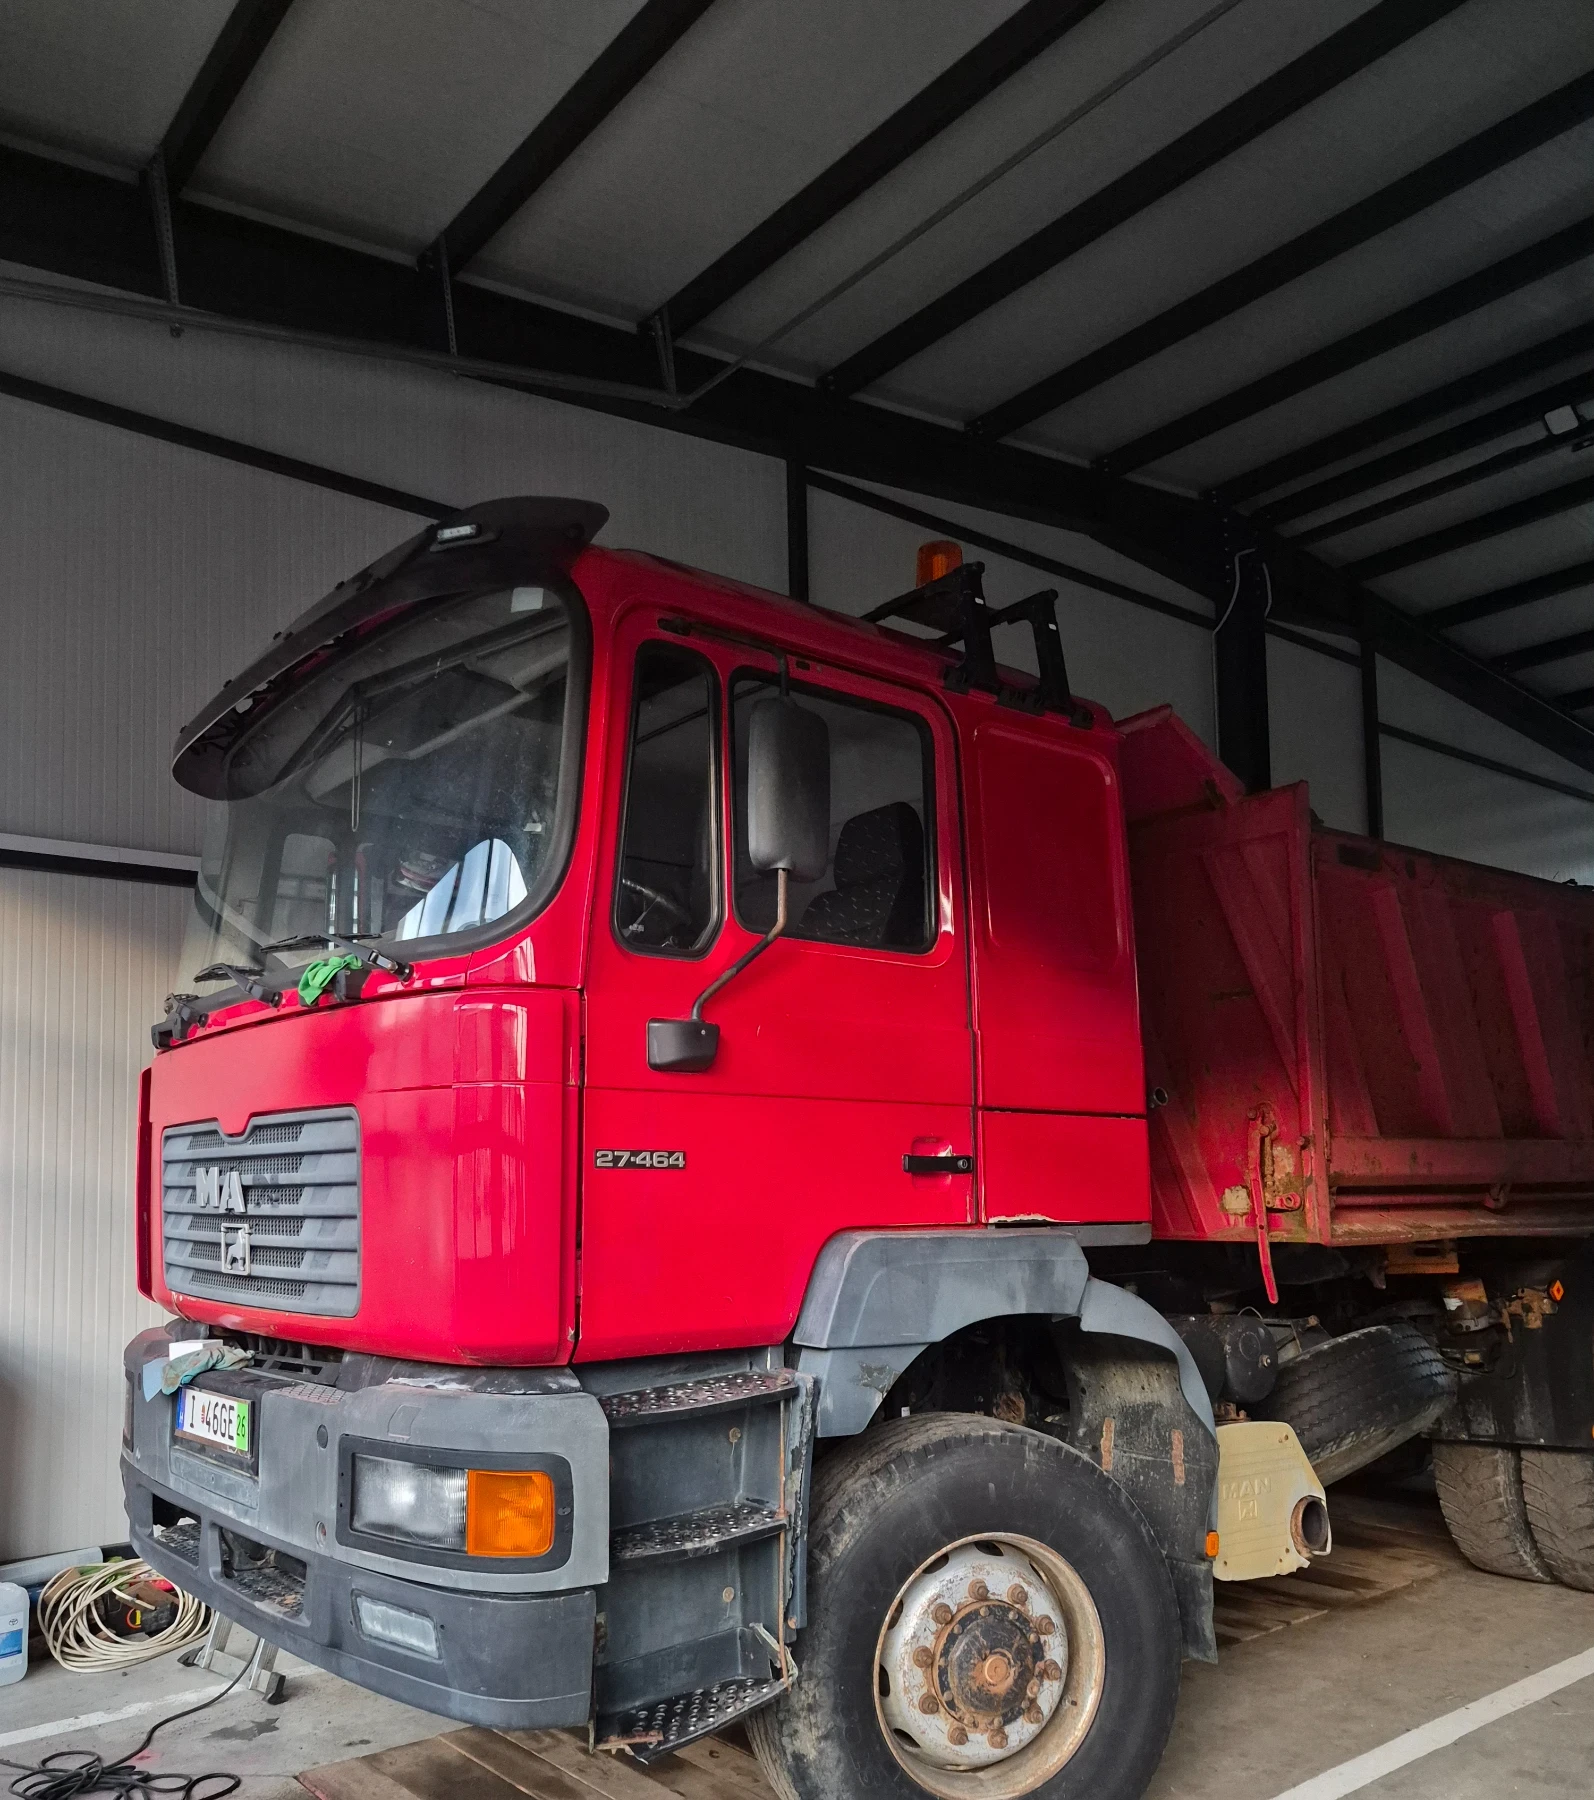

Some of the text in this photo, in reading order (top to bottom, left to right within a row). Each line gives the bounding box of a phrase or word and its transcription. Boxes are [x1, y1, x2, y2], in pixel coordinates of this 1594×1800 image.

[205, 1400, 235, 1441] 46GE
[236, 1413, 246, 1438] 26
[1223, 1477, 1271, 1500] MAN
